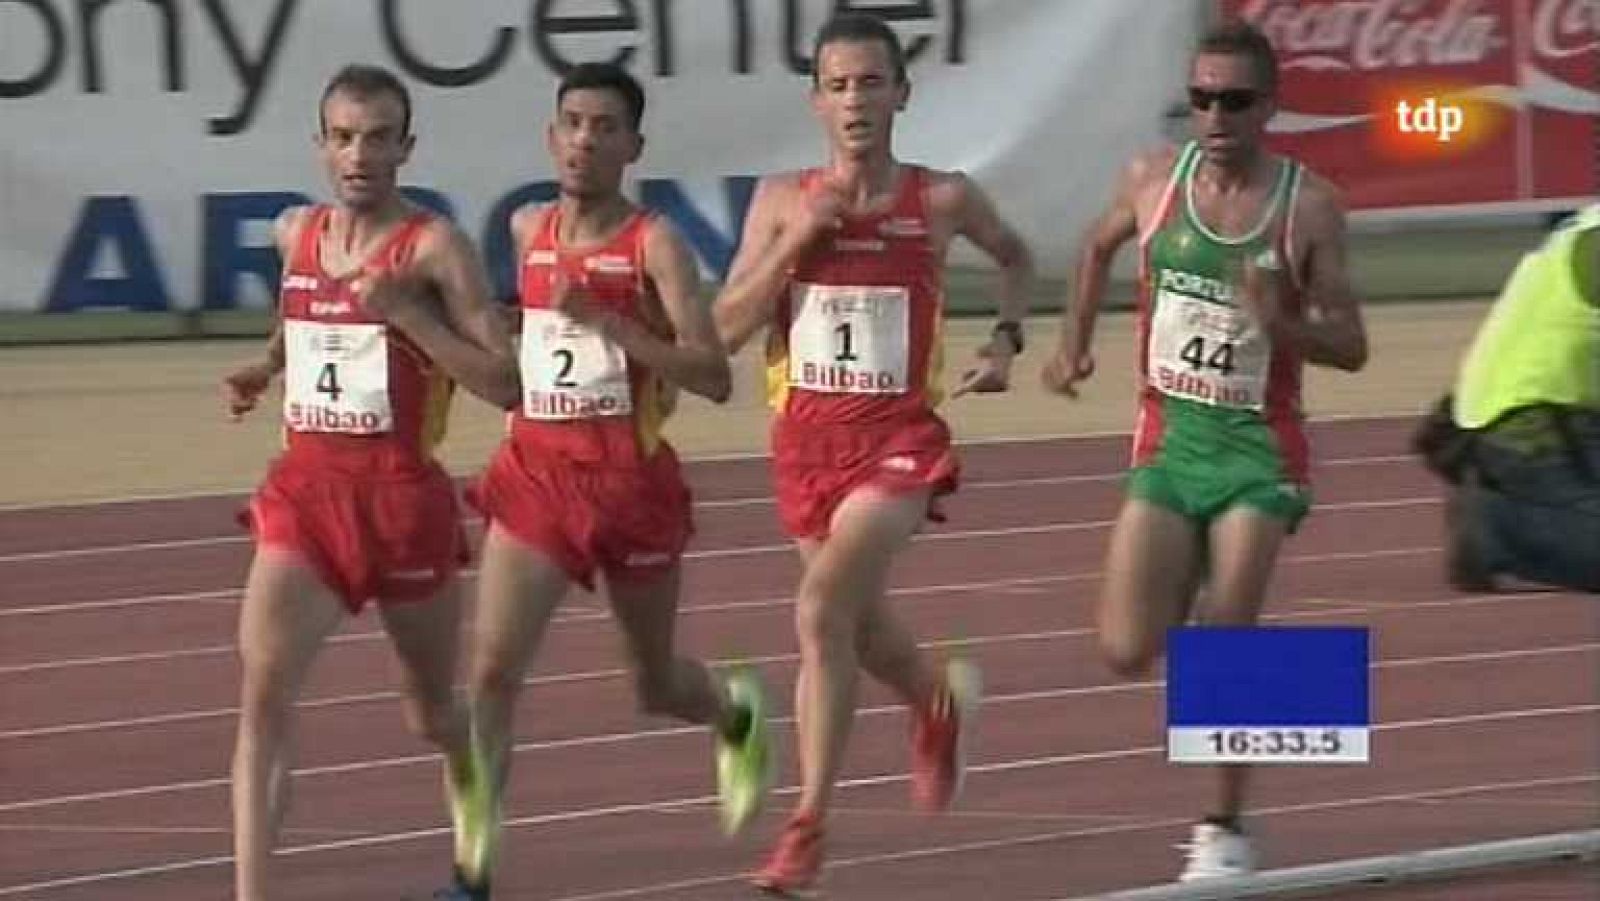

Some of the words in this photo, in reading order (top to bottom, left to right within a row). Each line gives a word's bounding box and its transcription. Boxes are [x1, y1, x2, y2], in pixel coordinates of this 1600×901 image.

[834, 322, 857, 361] 1
[1180, 336, 1236, 376] 44
[315, 362, 343, 401] 4
[551, 349, 577, 387] 2
[803, 362, 894, 390] Bilbao
[288, 402, 379, 430] Bilbao
